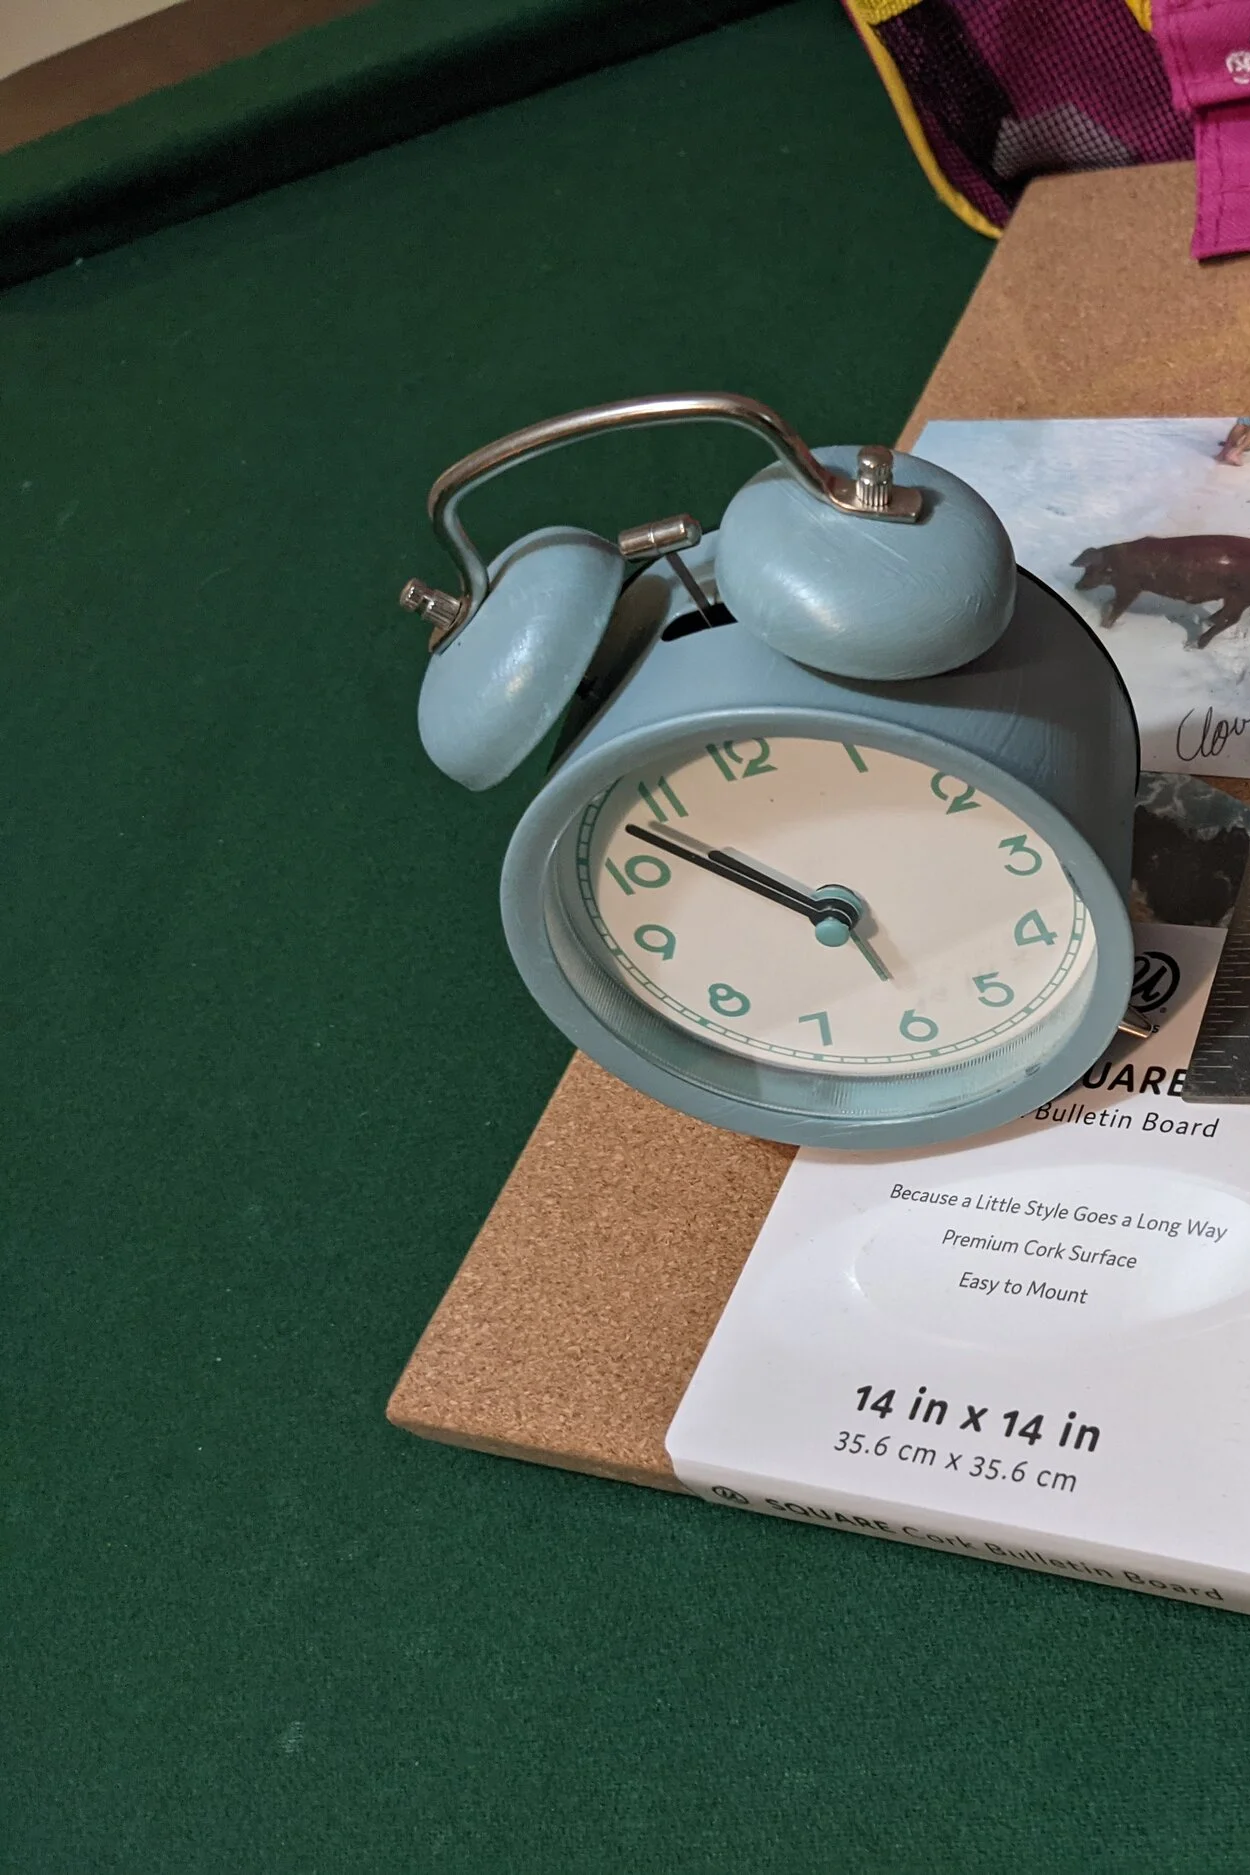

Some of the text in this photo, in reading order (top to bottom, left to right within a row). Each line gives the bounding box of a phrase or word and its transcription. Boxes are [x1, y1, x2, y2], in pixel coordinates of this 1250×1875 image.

[705, 736, 779, 783] 12
[636, 775, 690, 824] 11
[929, 771, 982, 815] 2
[604, 854, 673, 897] 10
[996, 834, 1044, 878] 3
[632, 923, 679, 963] 9
[1013, 908, 1059, 948] 4
[706, 981, 752, 1019] 8
[971, 971, 1015, 1009] 5
[798, 1010, 834, 1048] 7
[900, 1008, 940, 1044] 6
[1079, 1062, 1188, 1098] UARE
[1034, 1102, 1221, 1139] Bulletin Board
[889, 1183, 1229, 1244] Because a Little Style Goes a Long Way
[941, 1228, 1139, 1269] Premium Cork Surface
[958, 1271, 1089, 1305] Easy to Mount
[856, 1385, 1101, 1452] 14 in x 14 in
[833, 1430, 1078, 1493] 35.6 cm x 35.6 cm
[764, 1497, 895, 1534] SQUARE
[901, 1525, 974, 1552] Cork
[984, 1541, 1115, 1580] Bulletin
[1122, 1569, 1225, 1602] Board
